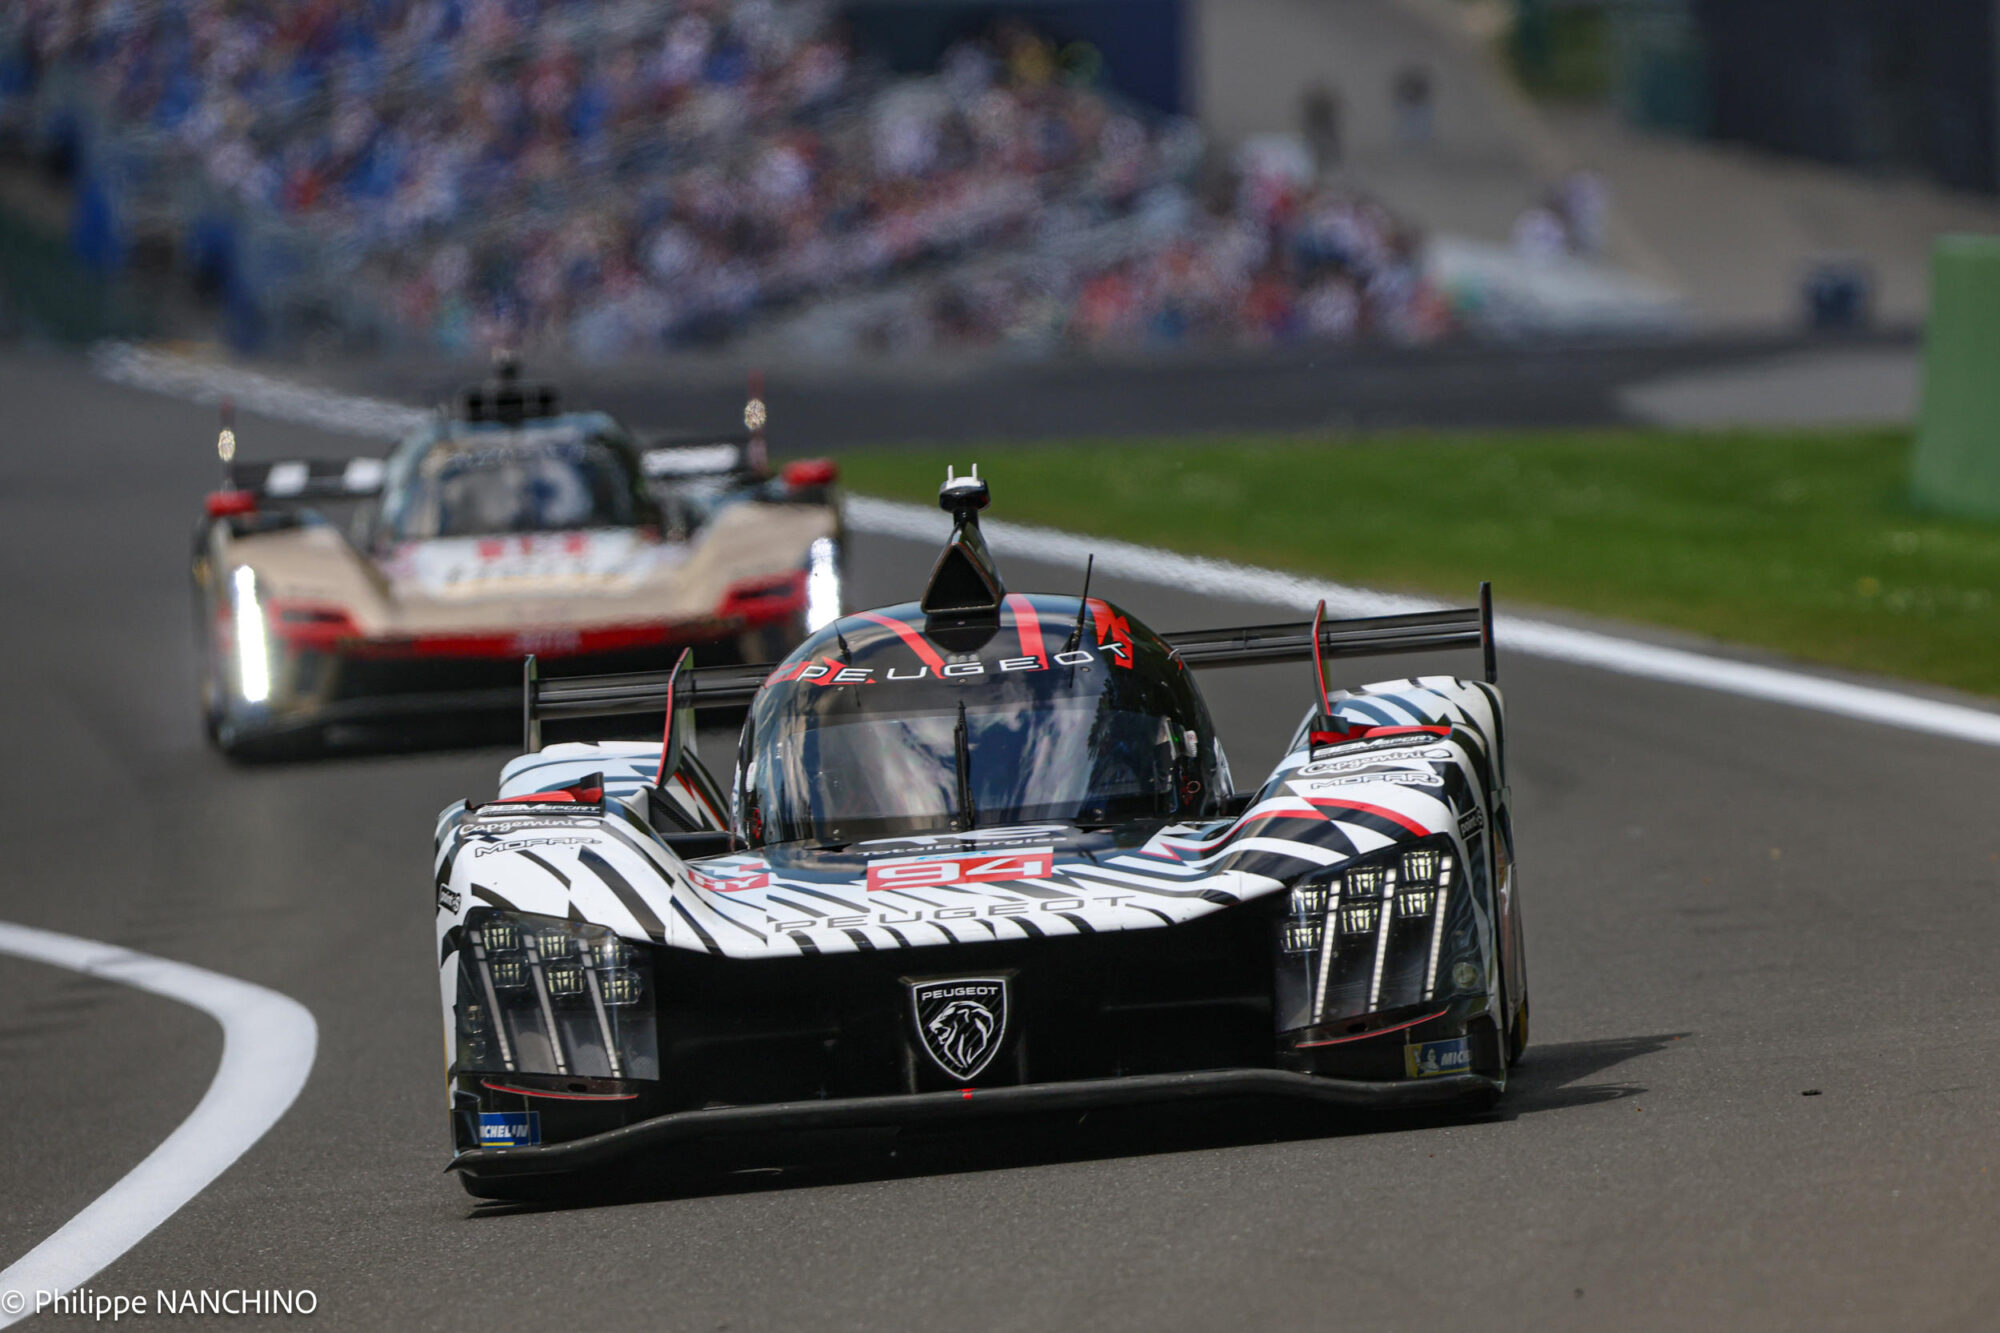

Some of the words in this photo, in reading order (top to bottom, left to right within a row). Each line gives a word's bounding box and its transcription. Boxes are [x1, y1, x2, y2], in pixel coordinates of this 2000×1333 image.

[796, 642, 1126, 683] PEUGEOT
[1305, 750, 1424, 773] Capgemini
[459, 819, 574, 835] Capgemini
[855, 837, 1068, 856] TotalEnergies
[694, 873, 762, 890] HY
[876, 857, 1043, 888] 94
[775, 895, 1136, 934] PEUGEOT
[922, 986, 999, 1001] PEUGEOT
[480, 1125, 529, 1138] ICHELIN
